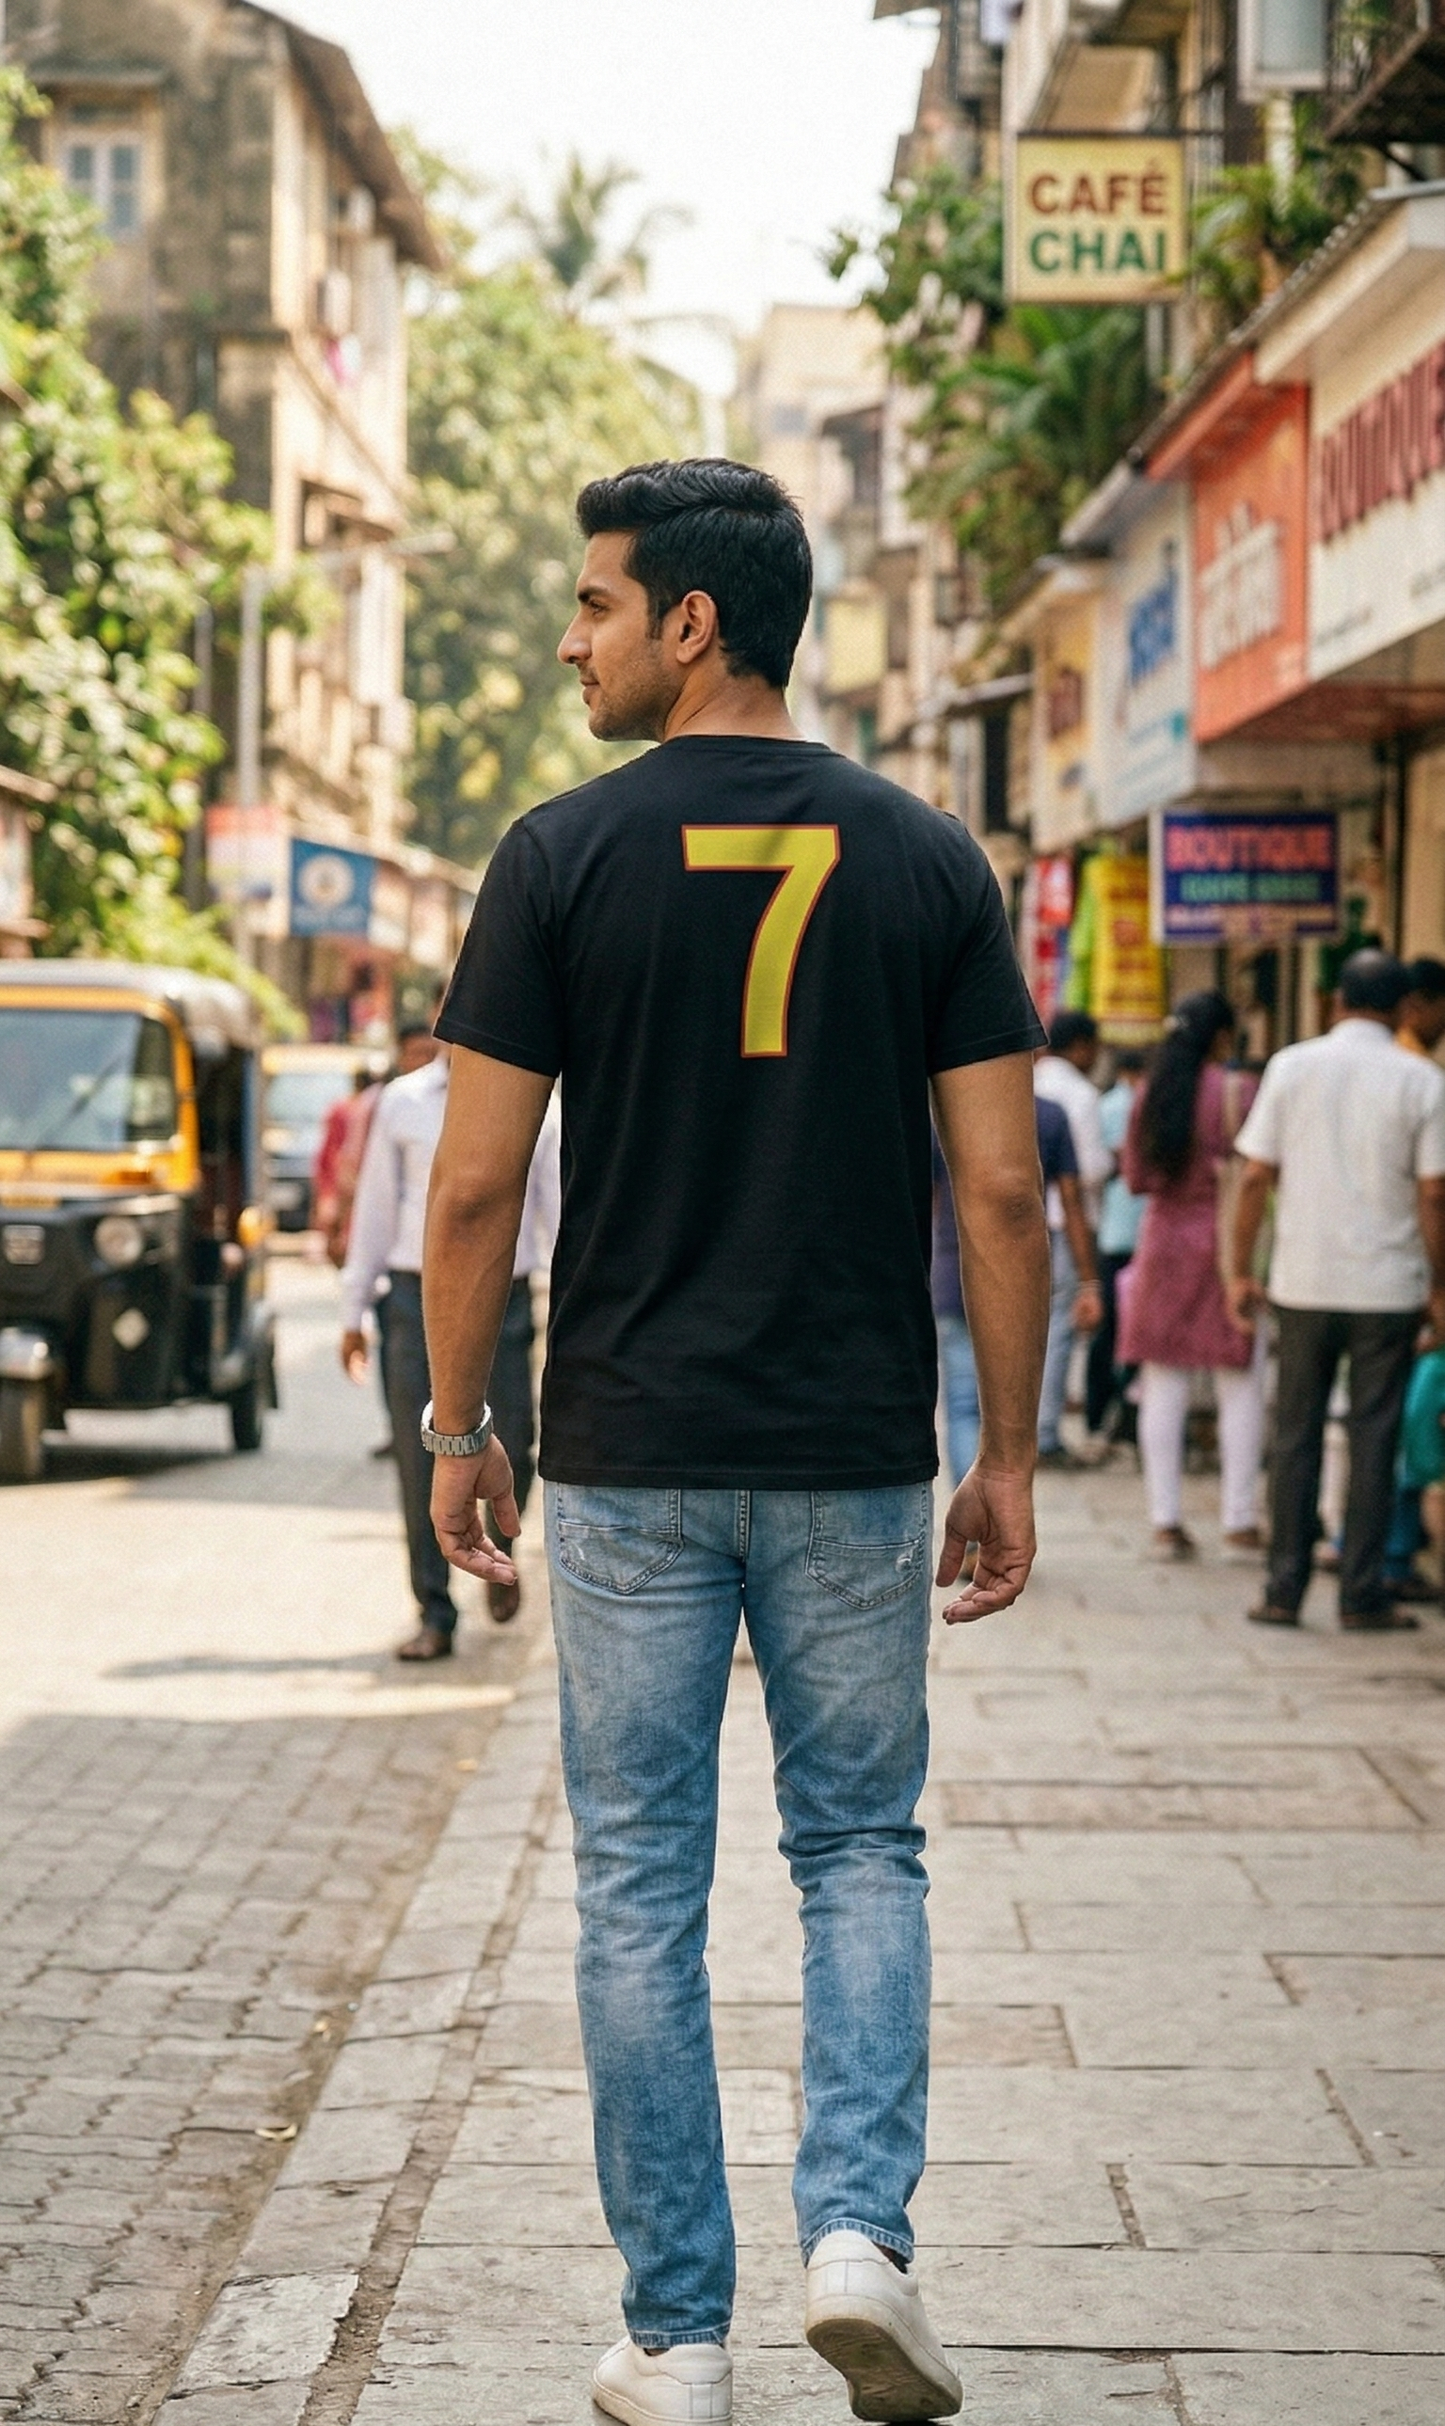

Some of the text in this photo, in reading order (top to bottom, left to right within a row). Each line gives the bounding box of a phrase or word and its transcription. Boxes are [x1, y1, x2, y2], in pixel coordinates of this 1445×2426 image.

[1027, 157, 1167, 215] CAFÉ
[1028, 229, 1167, 273] CHAI
[681, 824, 841, 1058] 7
